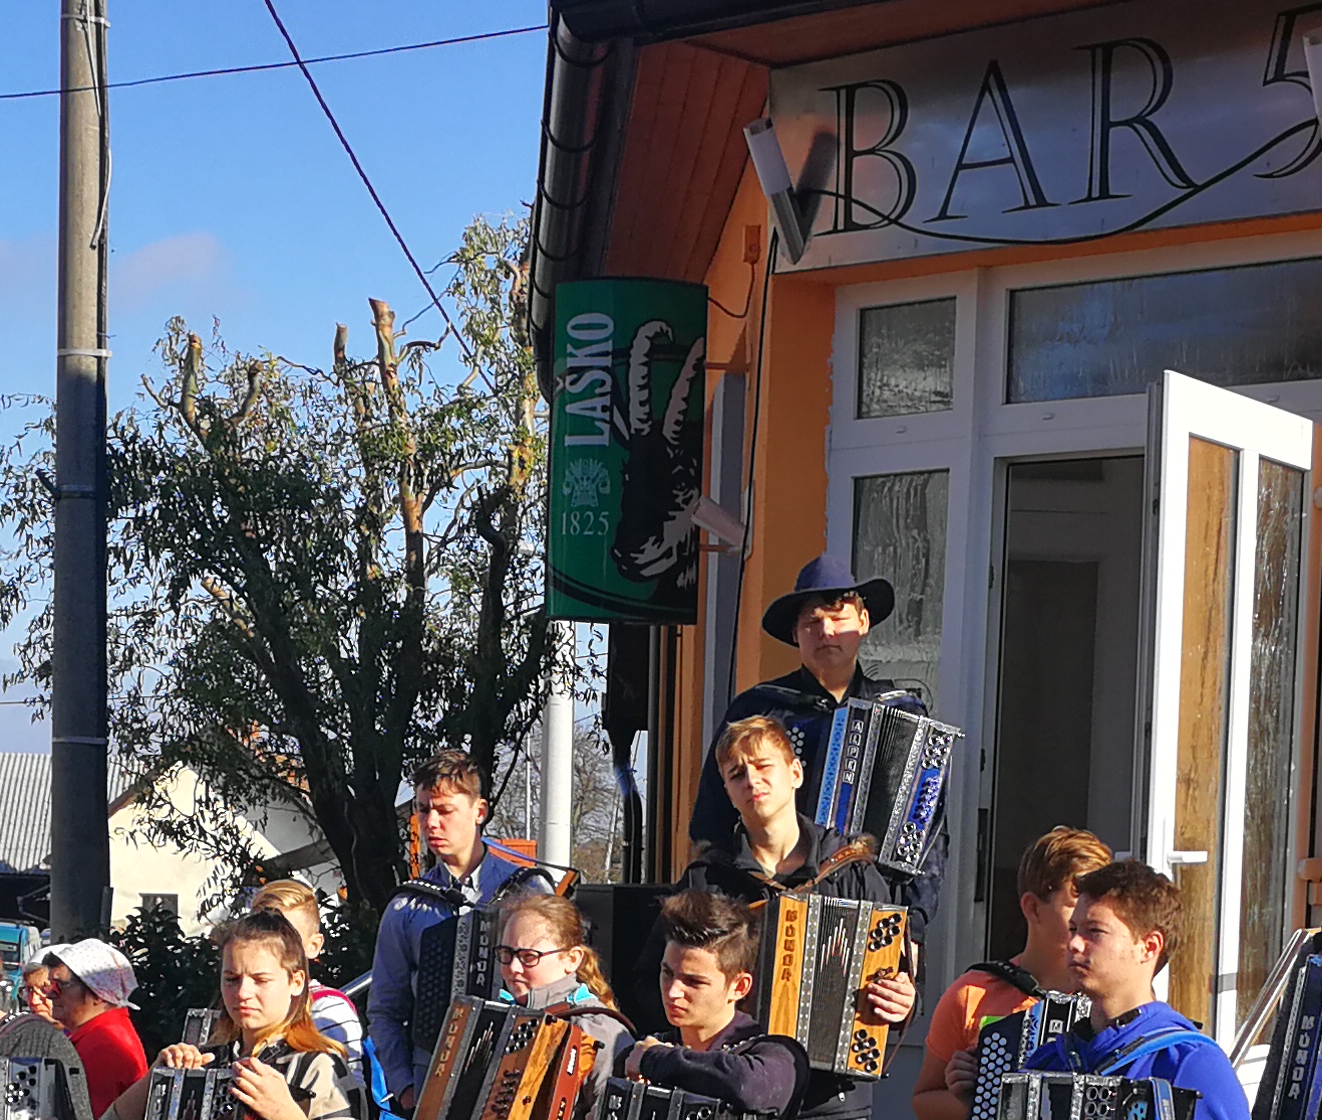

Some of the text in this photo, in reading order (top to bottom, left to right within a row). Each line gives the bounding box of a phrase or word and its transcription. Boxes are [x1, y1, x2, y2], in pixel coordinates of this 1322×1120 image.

[813, 35, 1202, 238] BAR
[555, 312, 615, 447] LAŠKO
[561, 510, 610, 537] 1825
[475, 920, 492, 987] MUNDA
[434, 1007, 465, 1077] MUNDA
[1287, 1014, 1316, 1100] MUNDA
